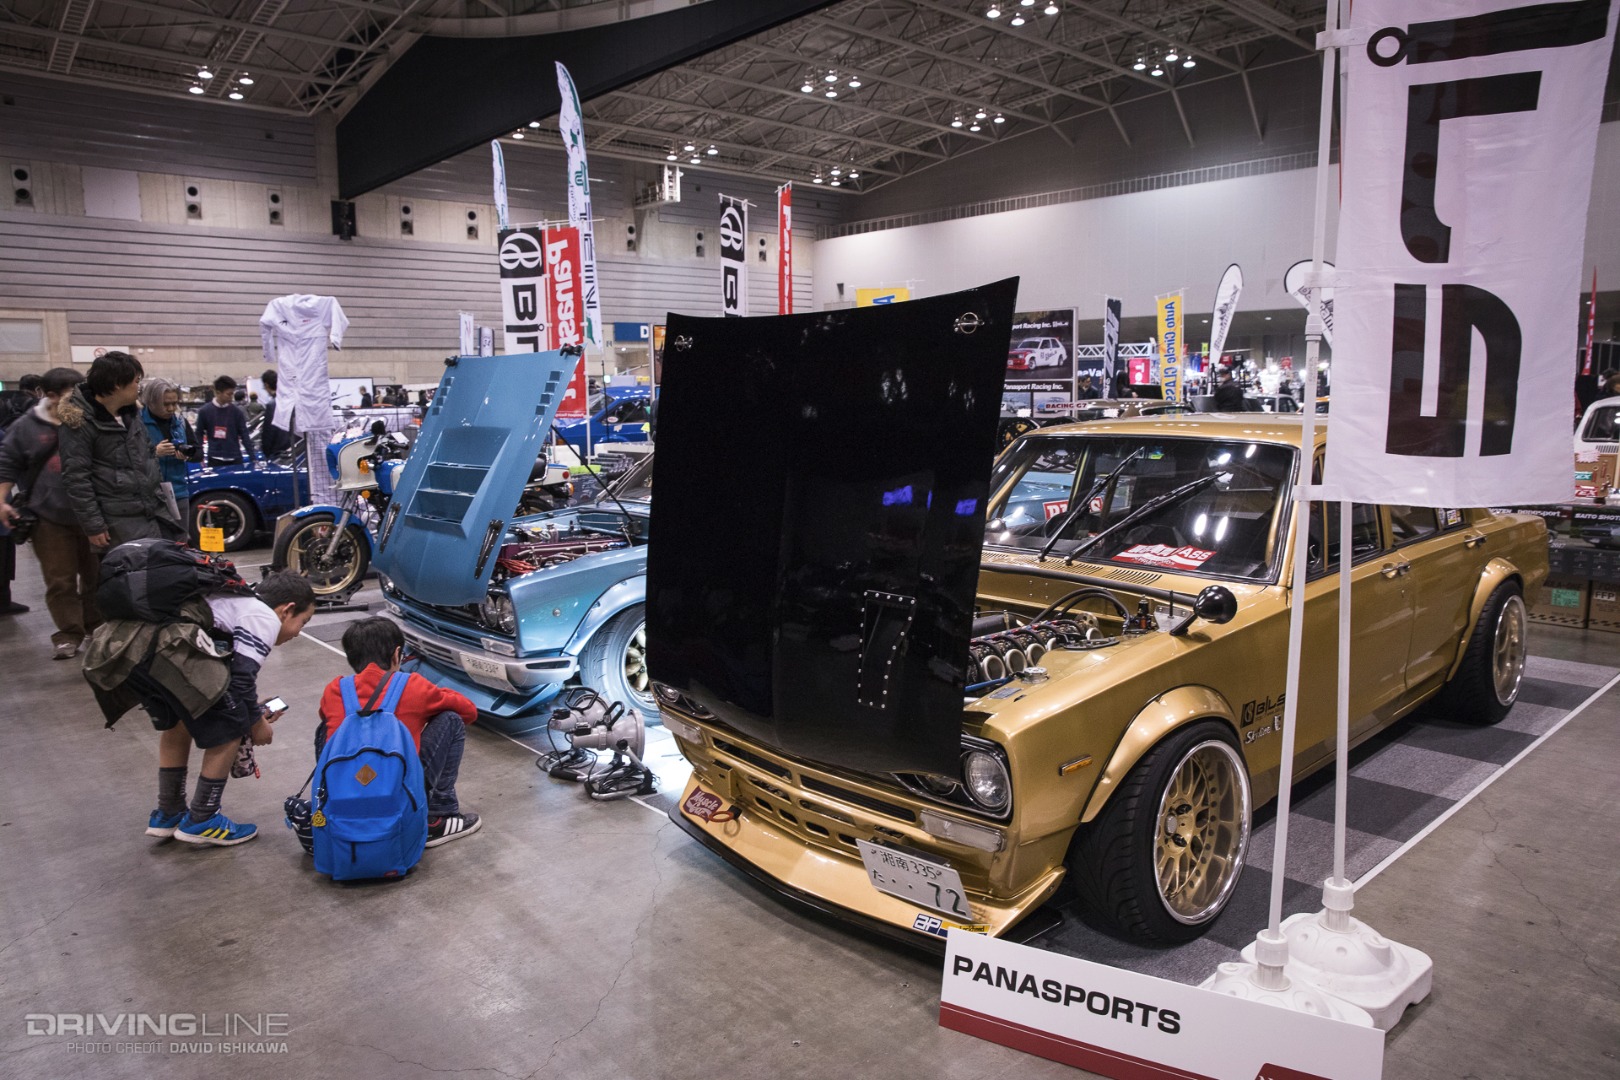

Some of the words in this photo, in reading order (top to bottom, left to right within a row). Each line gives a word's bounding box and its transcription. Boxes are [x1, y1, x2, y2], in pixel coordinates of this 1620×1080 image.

[1030, 383, 1052, 392] Racing
[690, 790, 719, 811] Muscle
[952, 954, 1181, 1036] PANASPORTS
